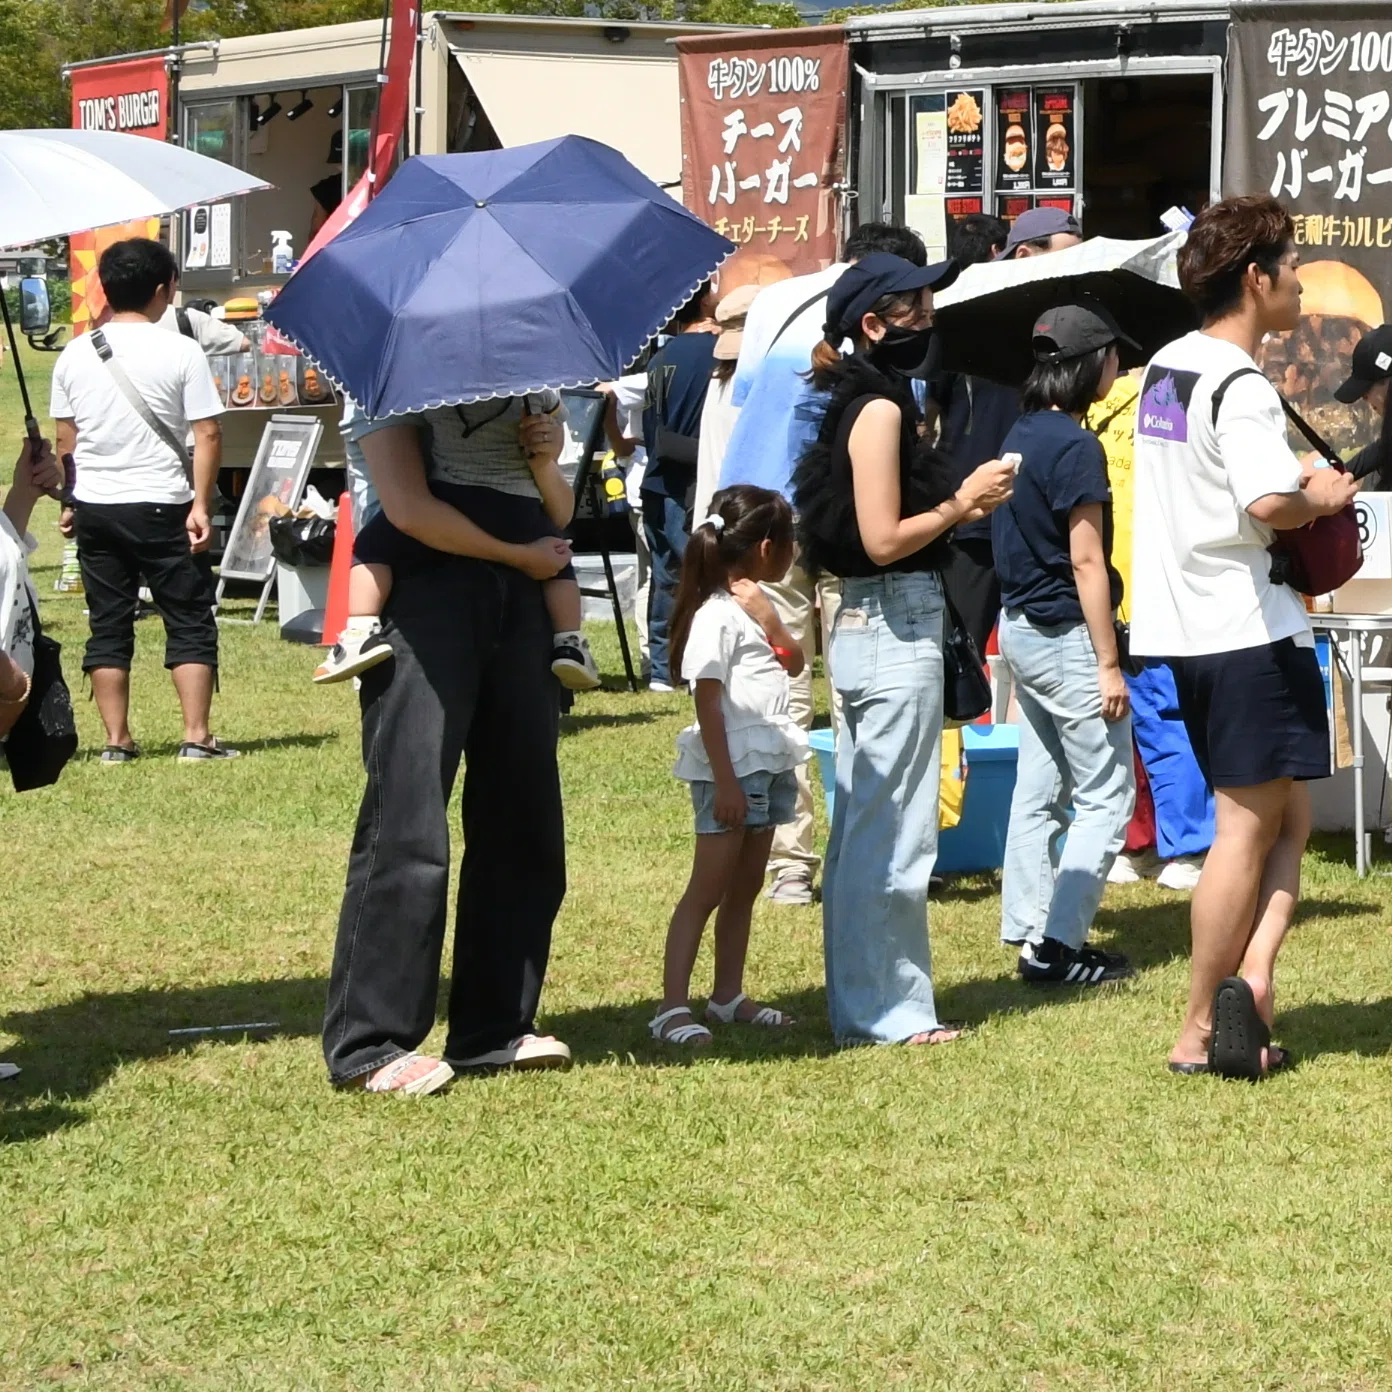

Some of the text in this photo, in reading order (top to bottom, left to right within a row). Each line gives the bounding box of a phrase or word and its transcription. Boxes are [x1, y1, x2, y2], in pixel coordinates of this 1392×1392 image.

[118, 89, 159, 128] BURGER
[721, 106, 804, 154] チーズ
[708, 156, 818, 204] バーガー
[715, 215, 809, 244] チェダーチーズ
